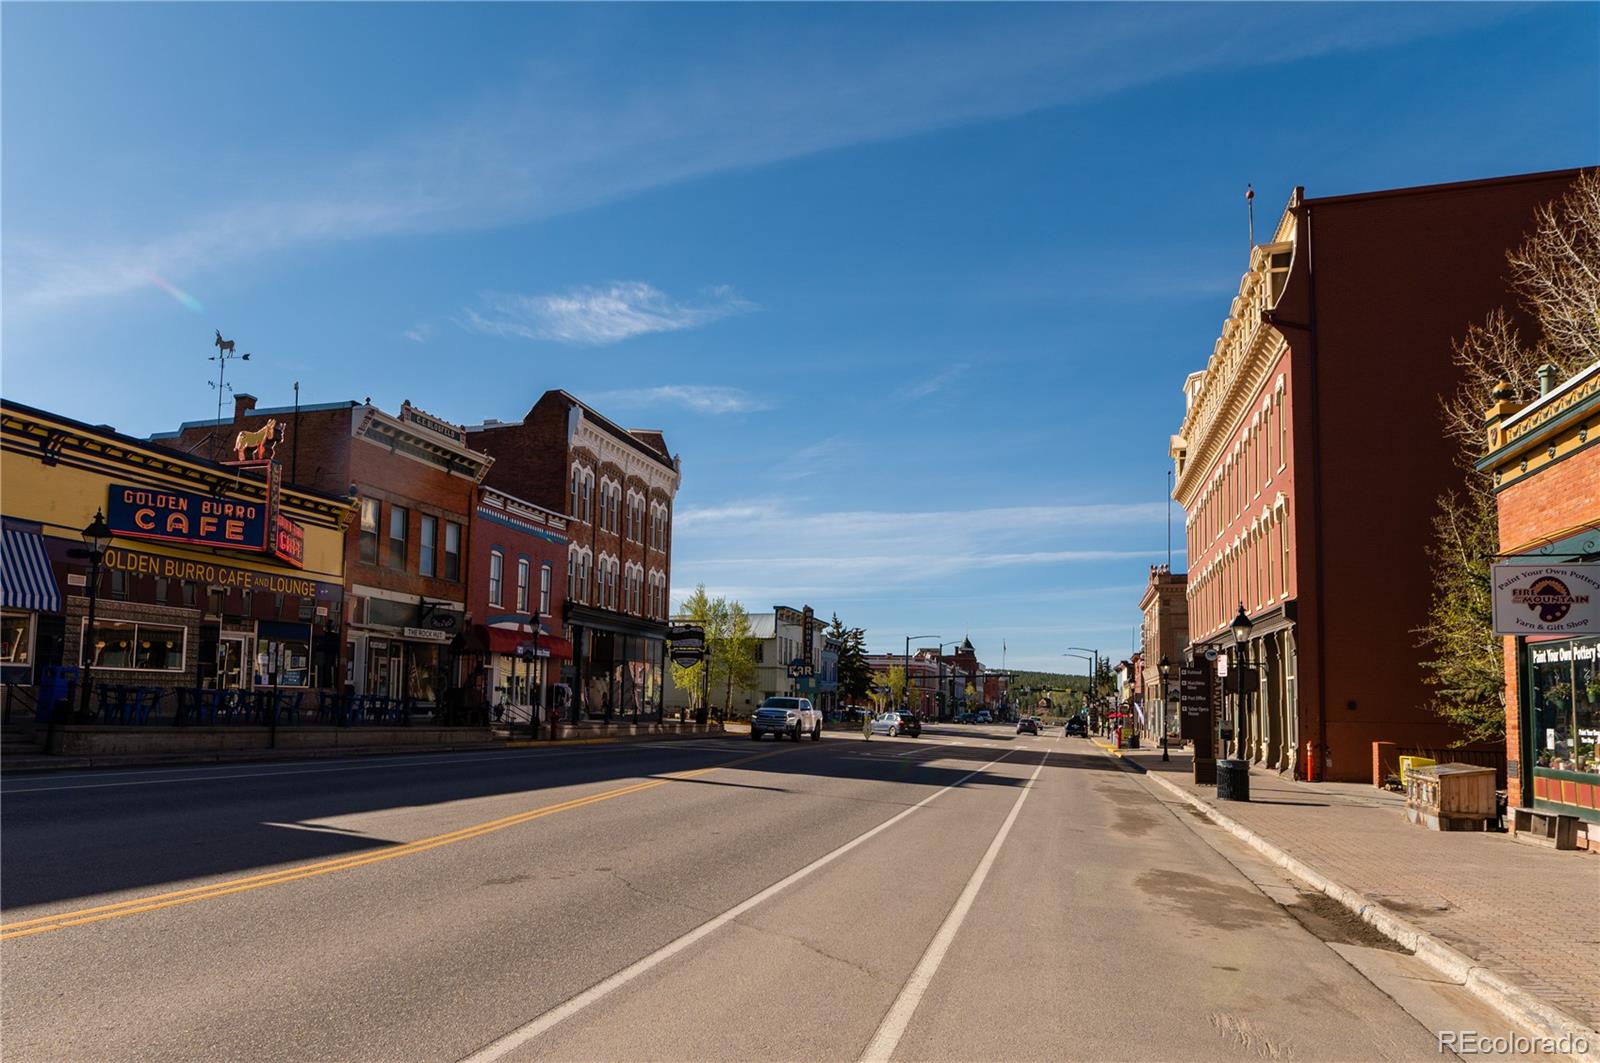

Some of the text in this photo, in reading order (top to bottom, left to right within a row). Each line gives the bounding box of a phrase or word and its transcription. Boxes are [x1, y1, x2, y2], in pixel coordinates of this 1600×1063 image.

[124, 490, 256, 519] GOLDEN BURRO
[134, 508, 245, 541] CAFE
[103, 550, 316, 597] OLDEN BURRO CAFE AND LOUNGE
[1498, 575, 1522, 591] Paint
[1521, 569, 1544, 578] Your
[1569, 570, 1600, 590] Pottery
[1512, 588, 1537, 596] FIRE
[1522, 595, 1590, 604] MOUNTAIN
[408, 628, 418, 636] THE
[1515, 617, 1535, 629] Yarn
[1547, 623, 1564, 631] Gift
[1566, 618, 1589, 629] Shop
[1533, 649, 1546, 663] Paint
[1546, 648, 1559, 662] Your
[1559, 648, 1572, 661] Own
[1573, 645, 1596, 662] Pottery
